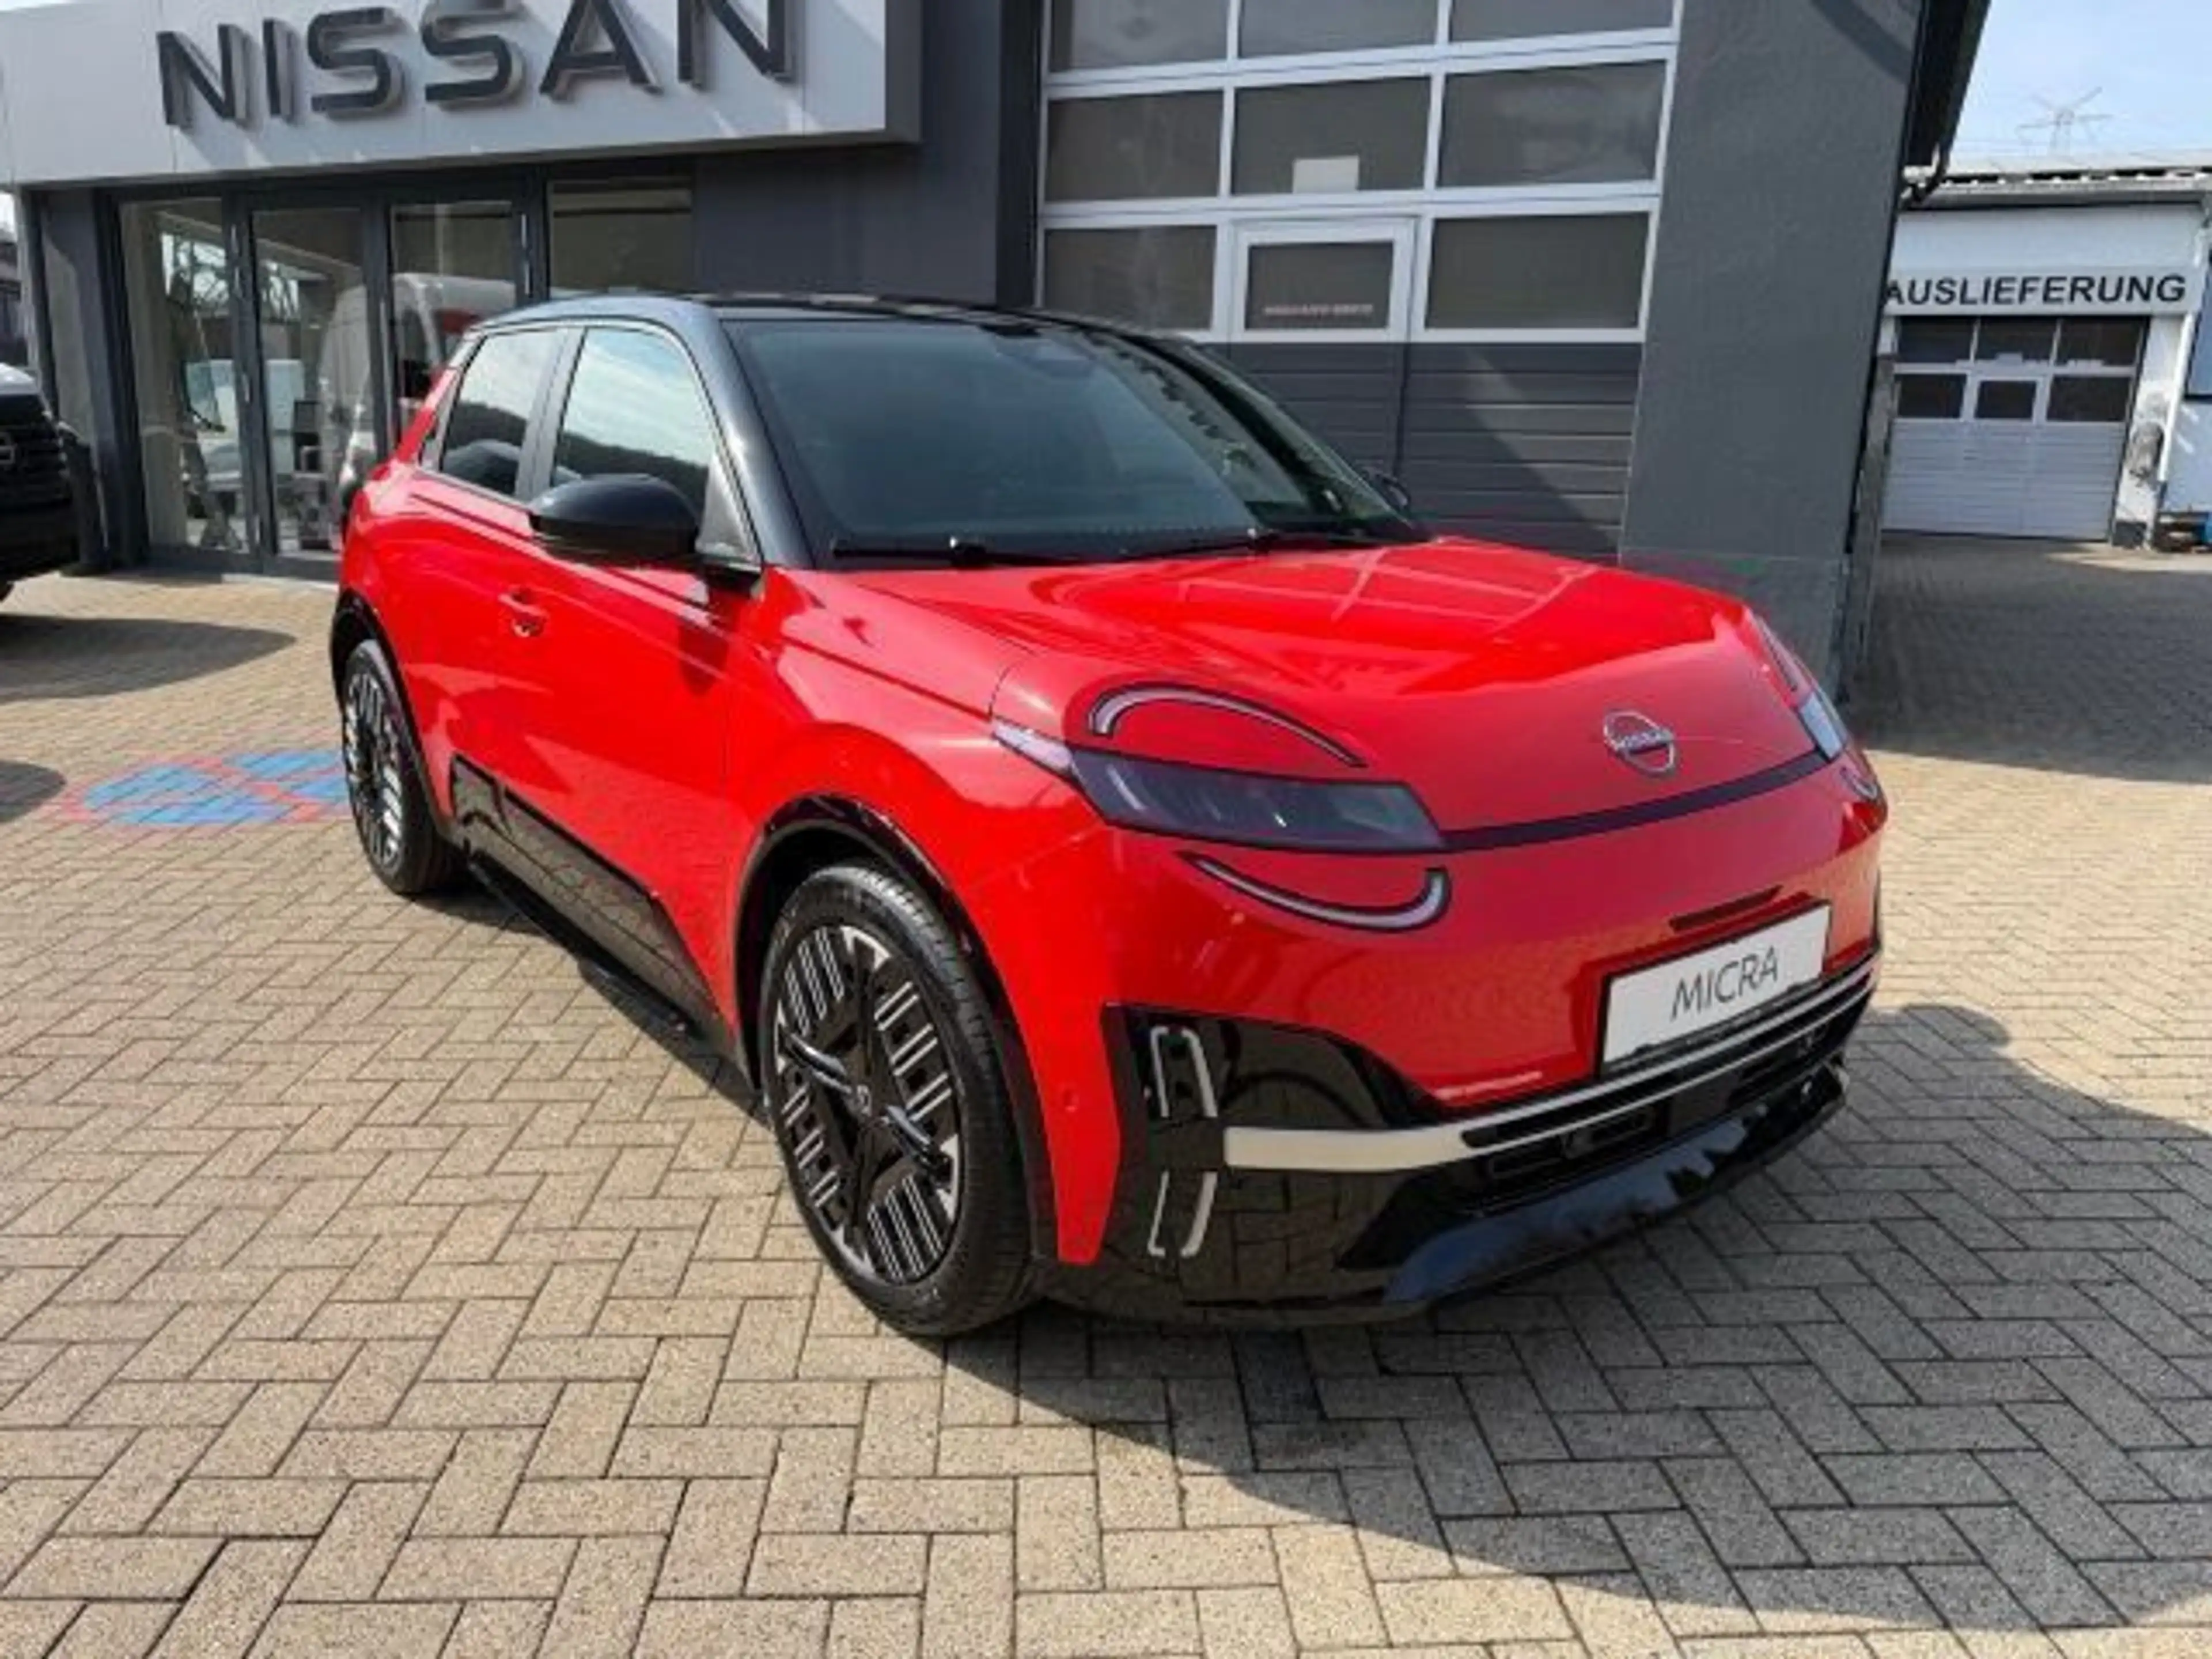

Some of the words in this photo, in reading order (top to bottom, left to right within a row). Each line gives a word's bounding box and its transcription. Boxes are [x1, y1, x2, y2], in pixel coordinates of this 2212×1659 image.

[157, 0, 793, 127] NISSAN
[1884, 274, 2186, 306] AUSLIEFERUNG
[1672, 945, 1779, 1020] MICRA
